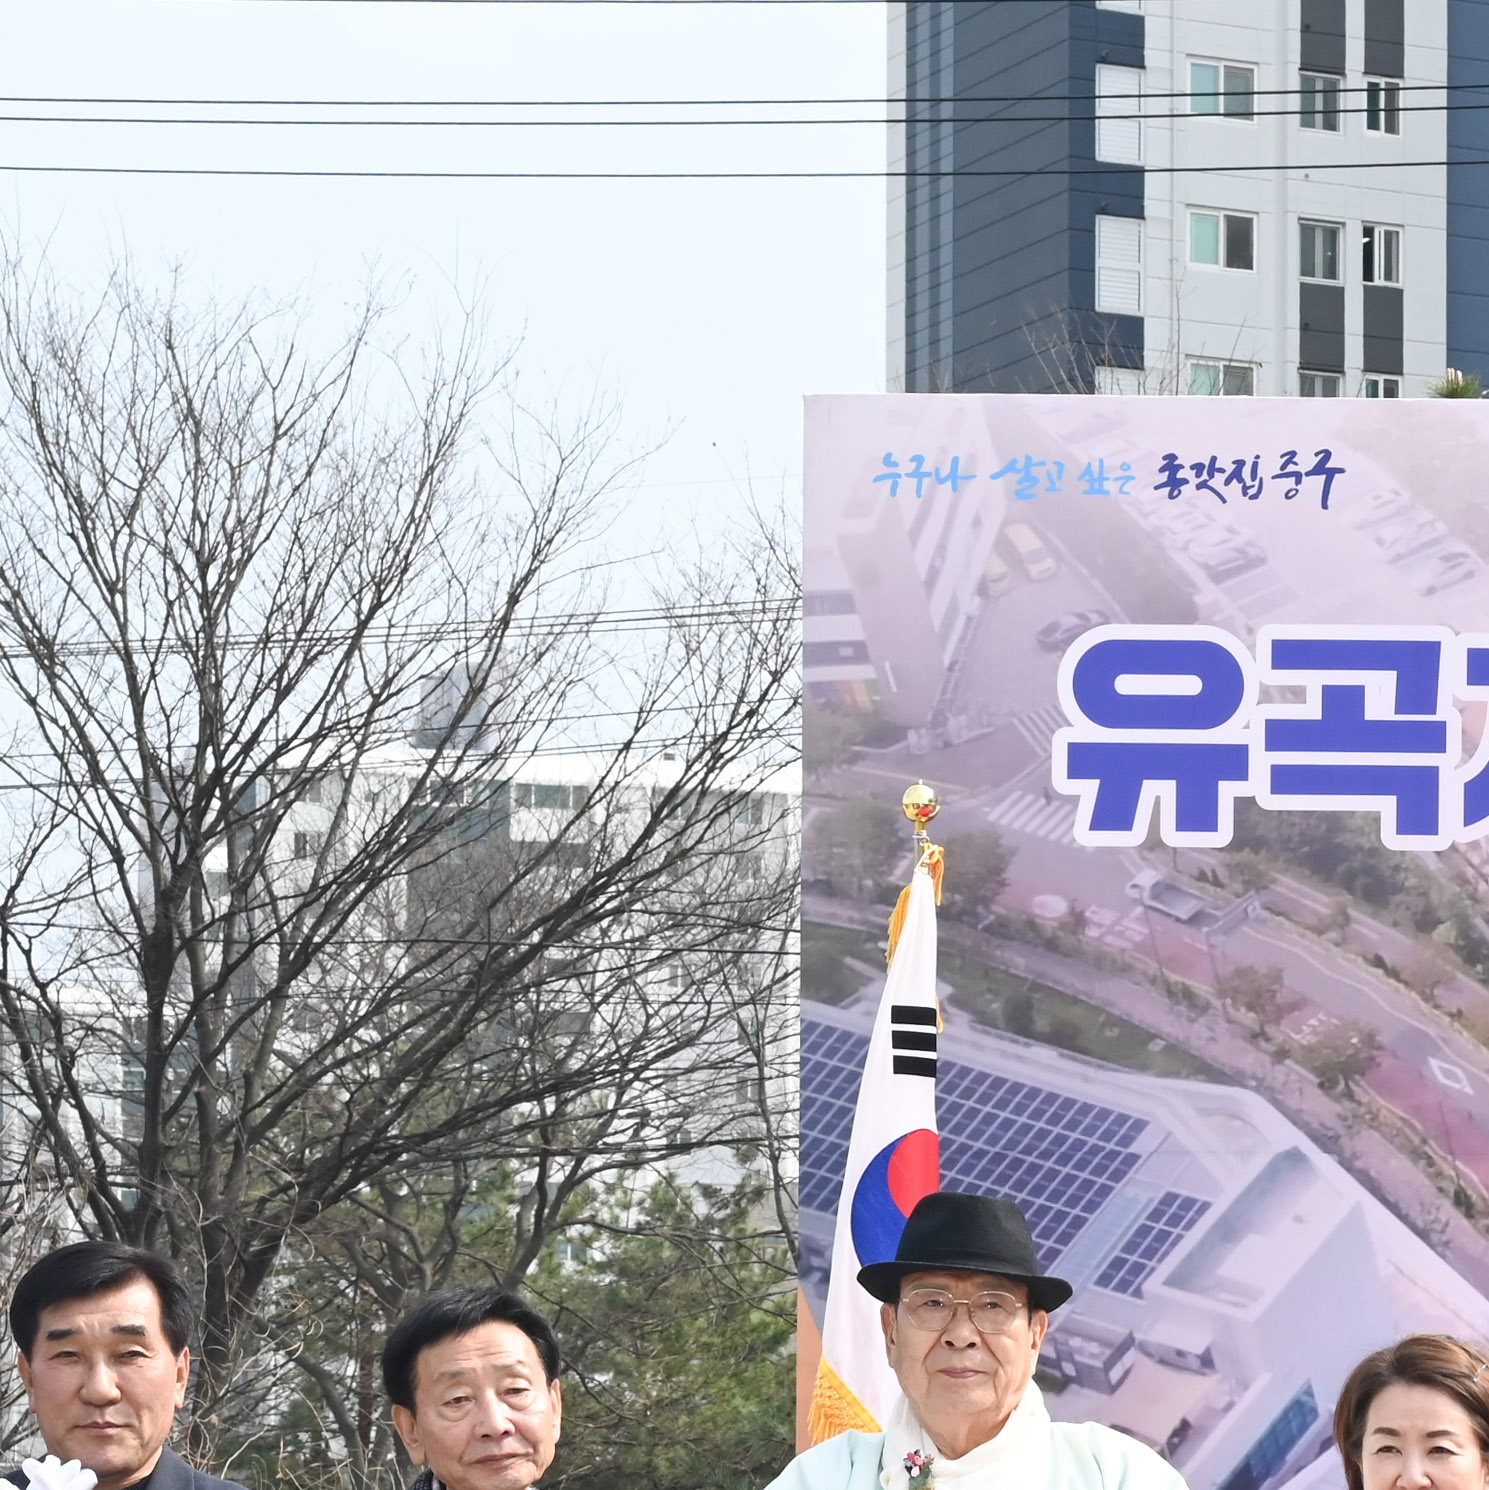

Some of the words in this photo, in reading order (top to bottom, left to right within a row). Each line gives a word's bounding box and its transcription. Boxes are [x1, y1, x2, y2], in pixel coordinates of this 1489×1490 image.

[872, 451, 977, 500] 누구나
[989, 454, 1066, 501] 살고
[1076, 457, 1137, 497] 싶은
[1153, 452, 1265, 505] 종갓집
[1271, 448, 1347, 510] 중구
